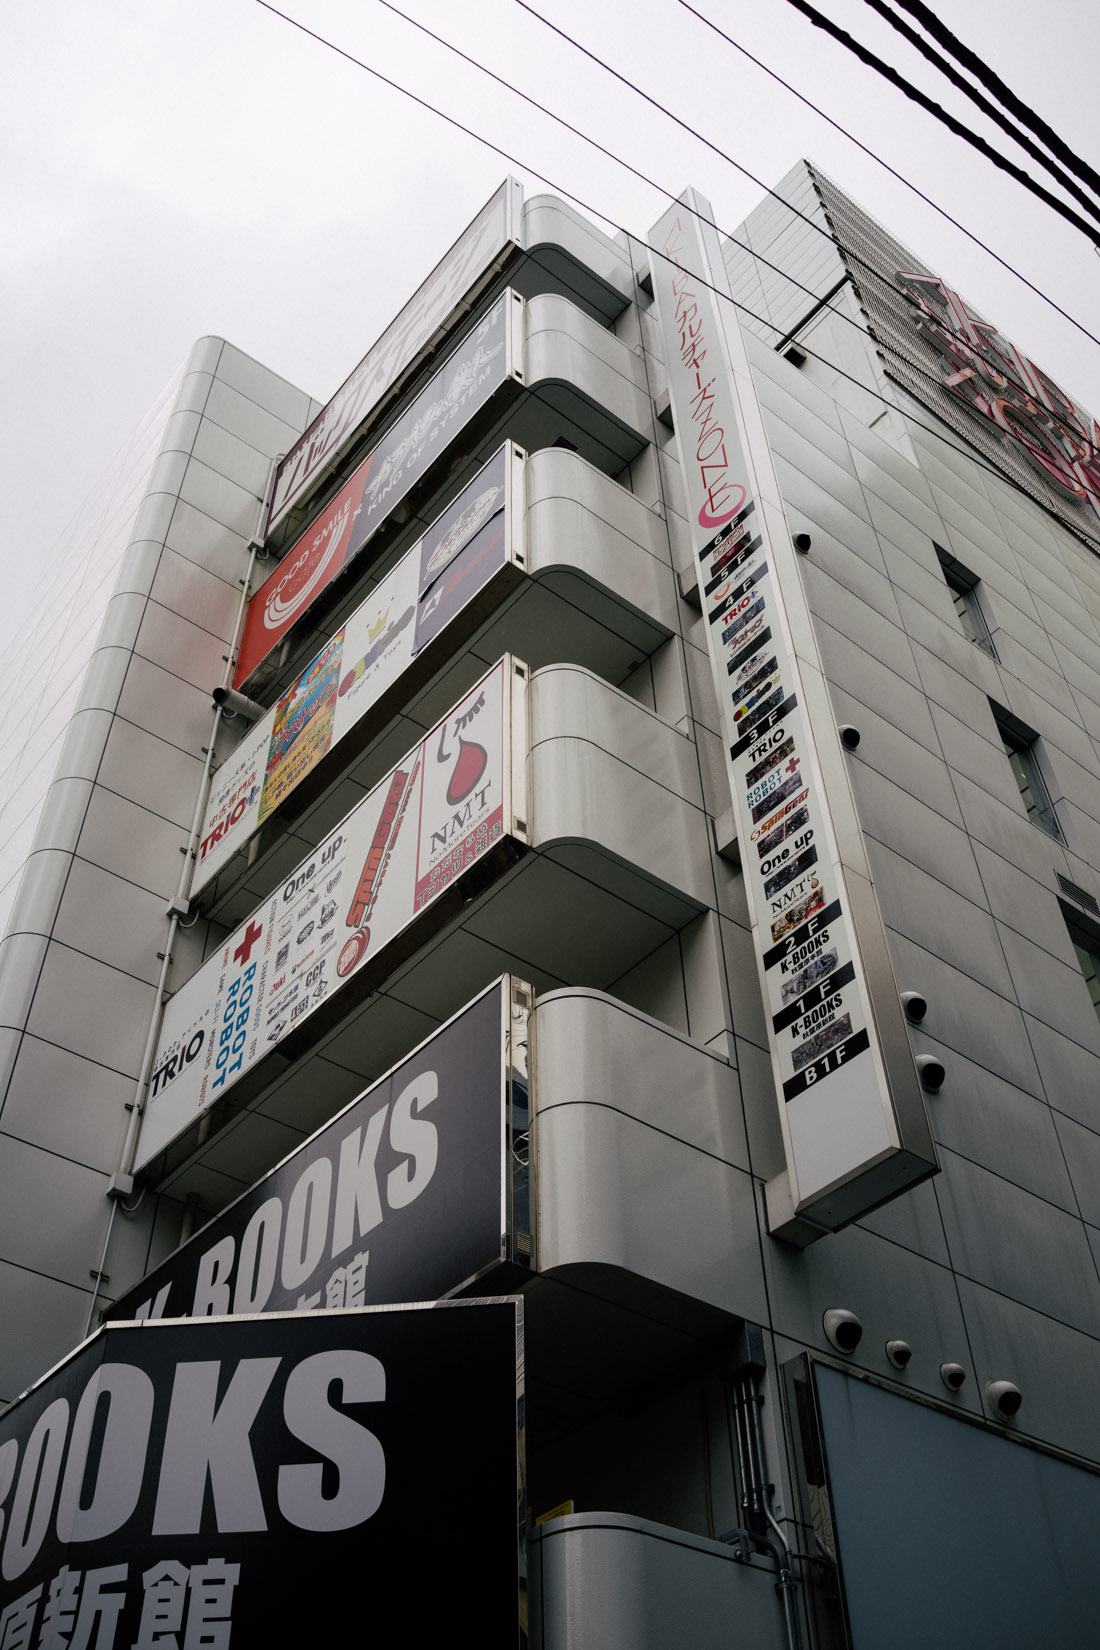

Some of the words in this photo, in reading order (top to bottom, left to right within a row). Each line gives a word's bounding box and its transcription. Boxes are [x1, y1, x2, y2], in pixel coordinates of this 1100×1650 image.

[477, 306, 504, 344] 5F
[368, 470, 403, 515] KING
[407, 442, 426, 468] OF
[431, 365, 491, 442] SYSTEM
[265, 551, 309, 607] GOOD
[313, 497, 352, 551] SMILE
[347, 673, 371, 700] Figure
[383, 640, 402, 660] Toys
[208, 769, 258, 828] 中古専門店
[746, 768, 782, 801] ROBOT
[747, 775, 784, 809] ROBOT
[429, 778, 492, 855] NMT
[429, 807, 491, 867] NoMoreTears
[430, 823, 487, 882] ただならぬ
[759, 848, 790, 876] One
[794, 829, 814, 850] up
[283, 863, 316, 902] One
[770, 879, 806, 914] NMT
[305, 959, 326, 987] CCP
[780, 930, 830, 974] K-BOOKS
[257, 960, 268, 1004] CHARACTER
[212, 976, 242, 1089] ROBOT
[228, 960, 257, 1074] ROBOT
[252, 1002, 262, 1032] GOODS
[791, 993, 843, 1039] K-BOOKS
[204, 1028, 216, 1070] MONSTERS
[249, 1037, 258, 1060] TOYS
[198, 1074, 209, 1107] ROBOTS
